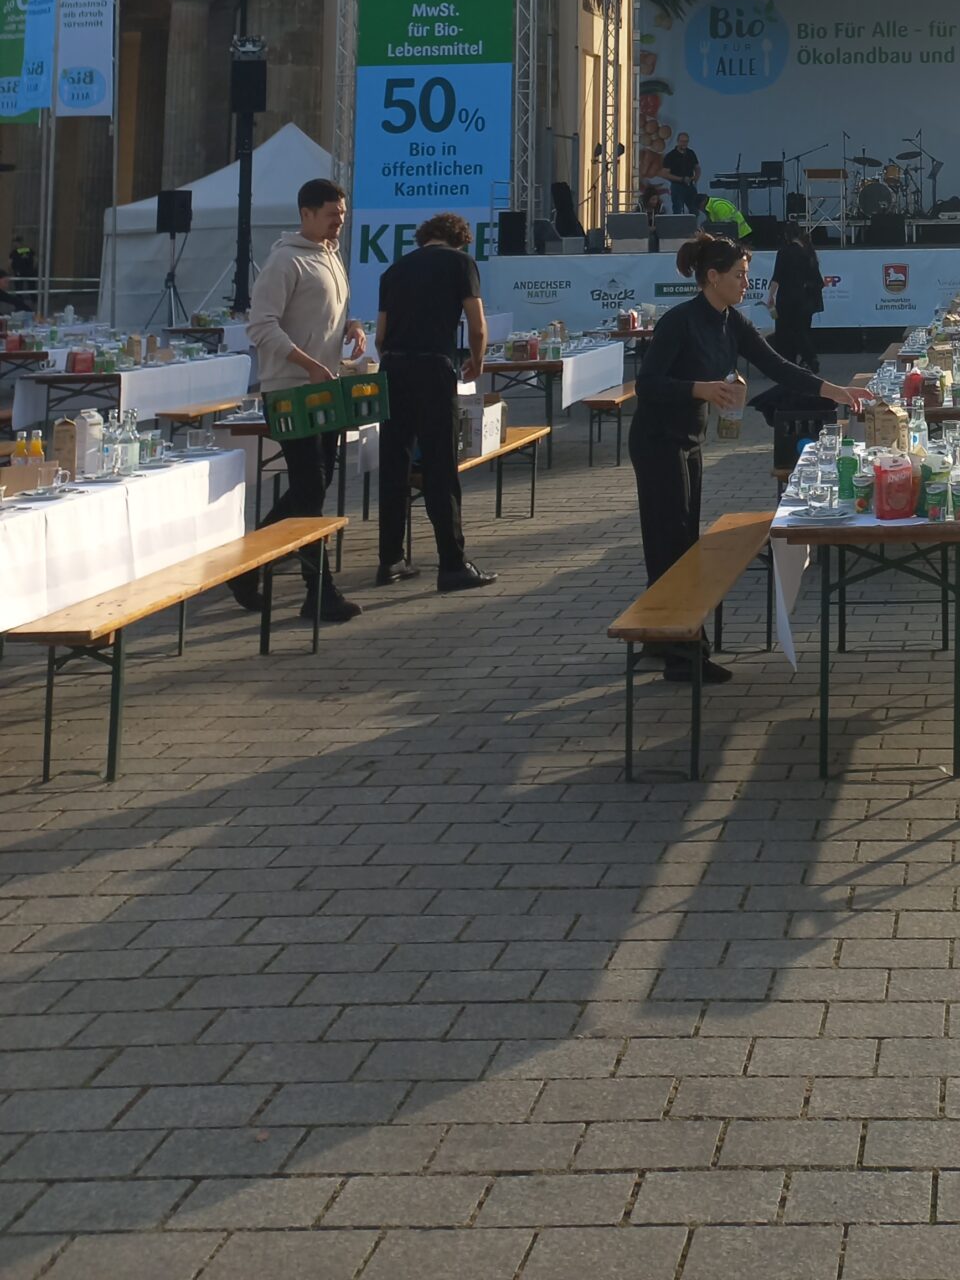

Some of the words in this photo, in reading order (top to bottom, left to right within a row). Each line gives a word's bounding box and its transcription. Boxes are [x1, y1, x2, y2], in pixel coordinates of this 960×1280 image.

[411, 3, 460, 17] MwSt.
[407, 22, 430, 37] für
[434, 22, 464, 37] Bio-
[709, 5, 766, 39] Bio
[797, 22, 828, 40] Bio
[833, 21, 866, 40] Für
[871, 21, 909, 39] Alle
[928, 20, 958, 38] für
[387, 40, 484, 57] Lebensmittel
[796, 46, 913, 66] Ökolandbau
[919, 46, 955, 64] und
[715, 56, 760, 76] ALLE
[381, 76, 486, 134] 50%
[409, 142, 436, 157] Bio
[441, 142, 457, 156] in
[381, 160, 484, 177] öffentlichen
[394, 182, 470, 197] Kantinen
[360, 222, 498, 264] KEE
[513, 280, 572, 290] ANDECHSER
[527, 290, 558, 299] NATUR
[601, 301, 624, 310] HOF
[875, 303, 917, 311] Lammsbräu
